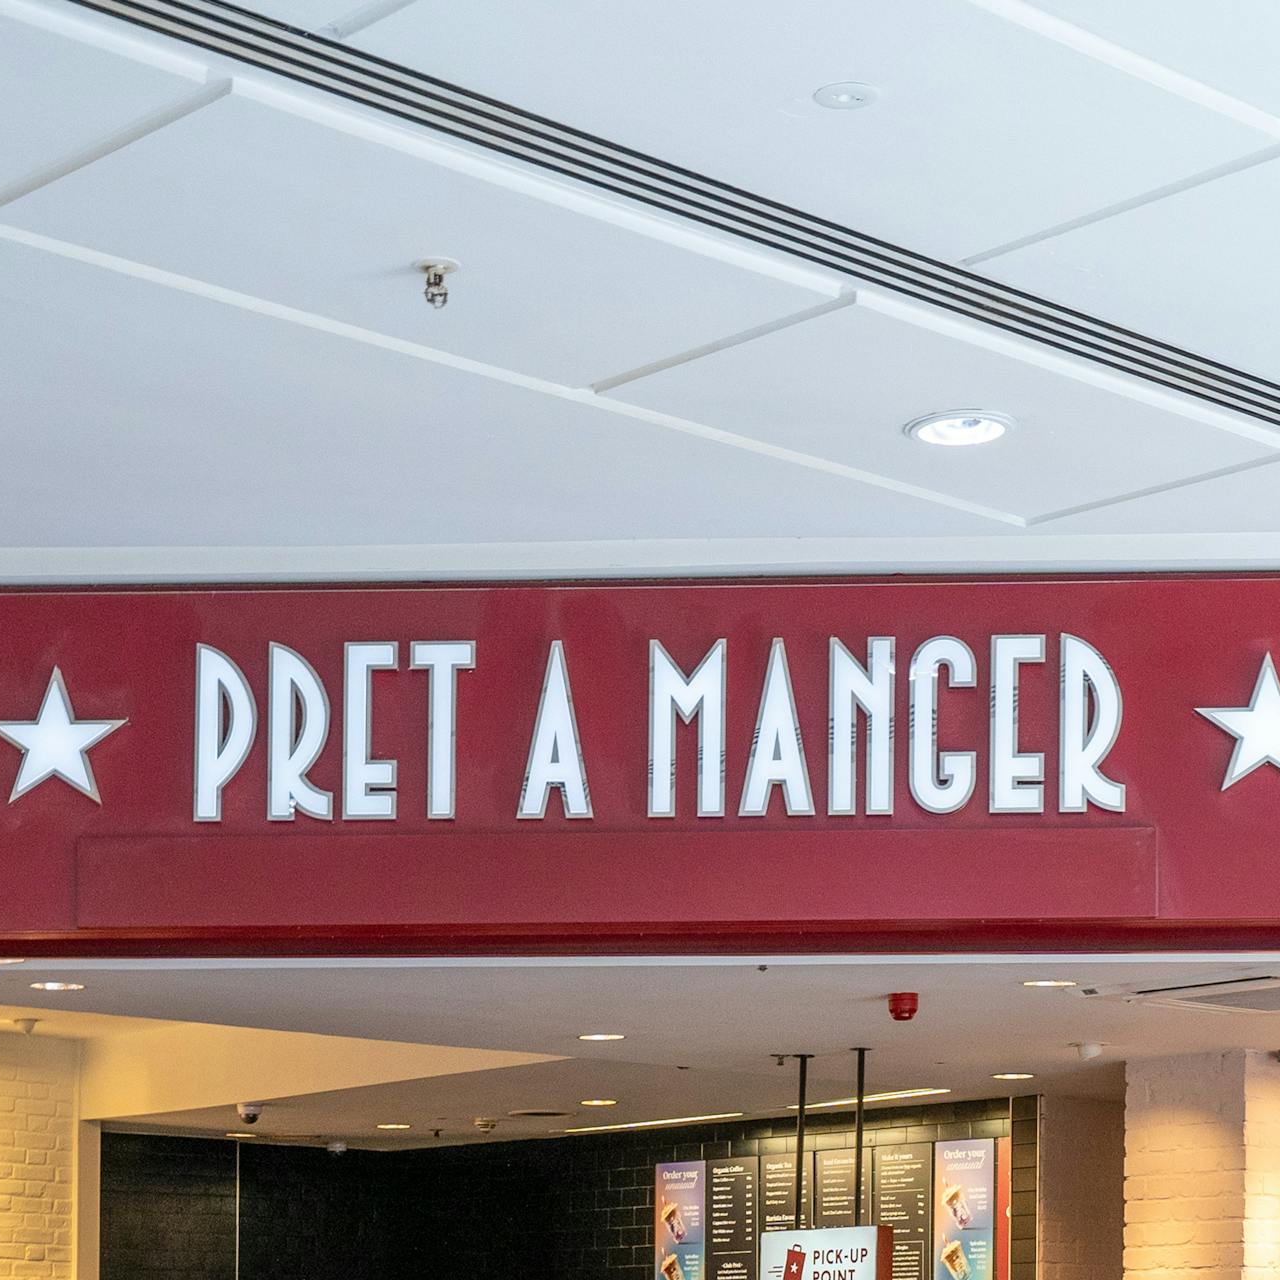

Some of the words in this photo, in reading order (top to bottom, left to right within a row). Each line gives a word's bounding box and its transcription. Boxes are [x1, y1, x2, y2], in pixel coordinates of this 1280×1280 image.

[193, 640, 476, 822] PRET
[516, 639, 594, 820] A
[648, 633, 1126, 818] MANGER
[943, 1149, 966, 1159] Order
[966, 1150, 986, 1161] your
[662, 1170, 682, 1180] Order
[682, 1171, 698, 1181] your
[813, 1248, 868, 1265] PICK-UP
